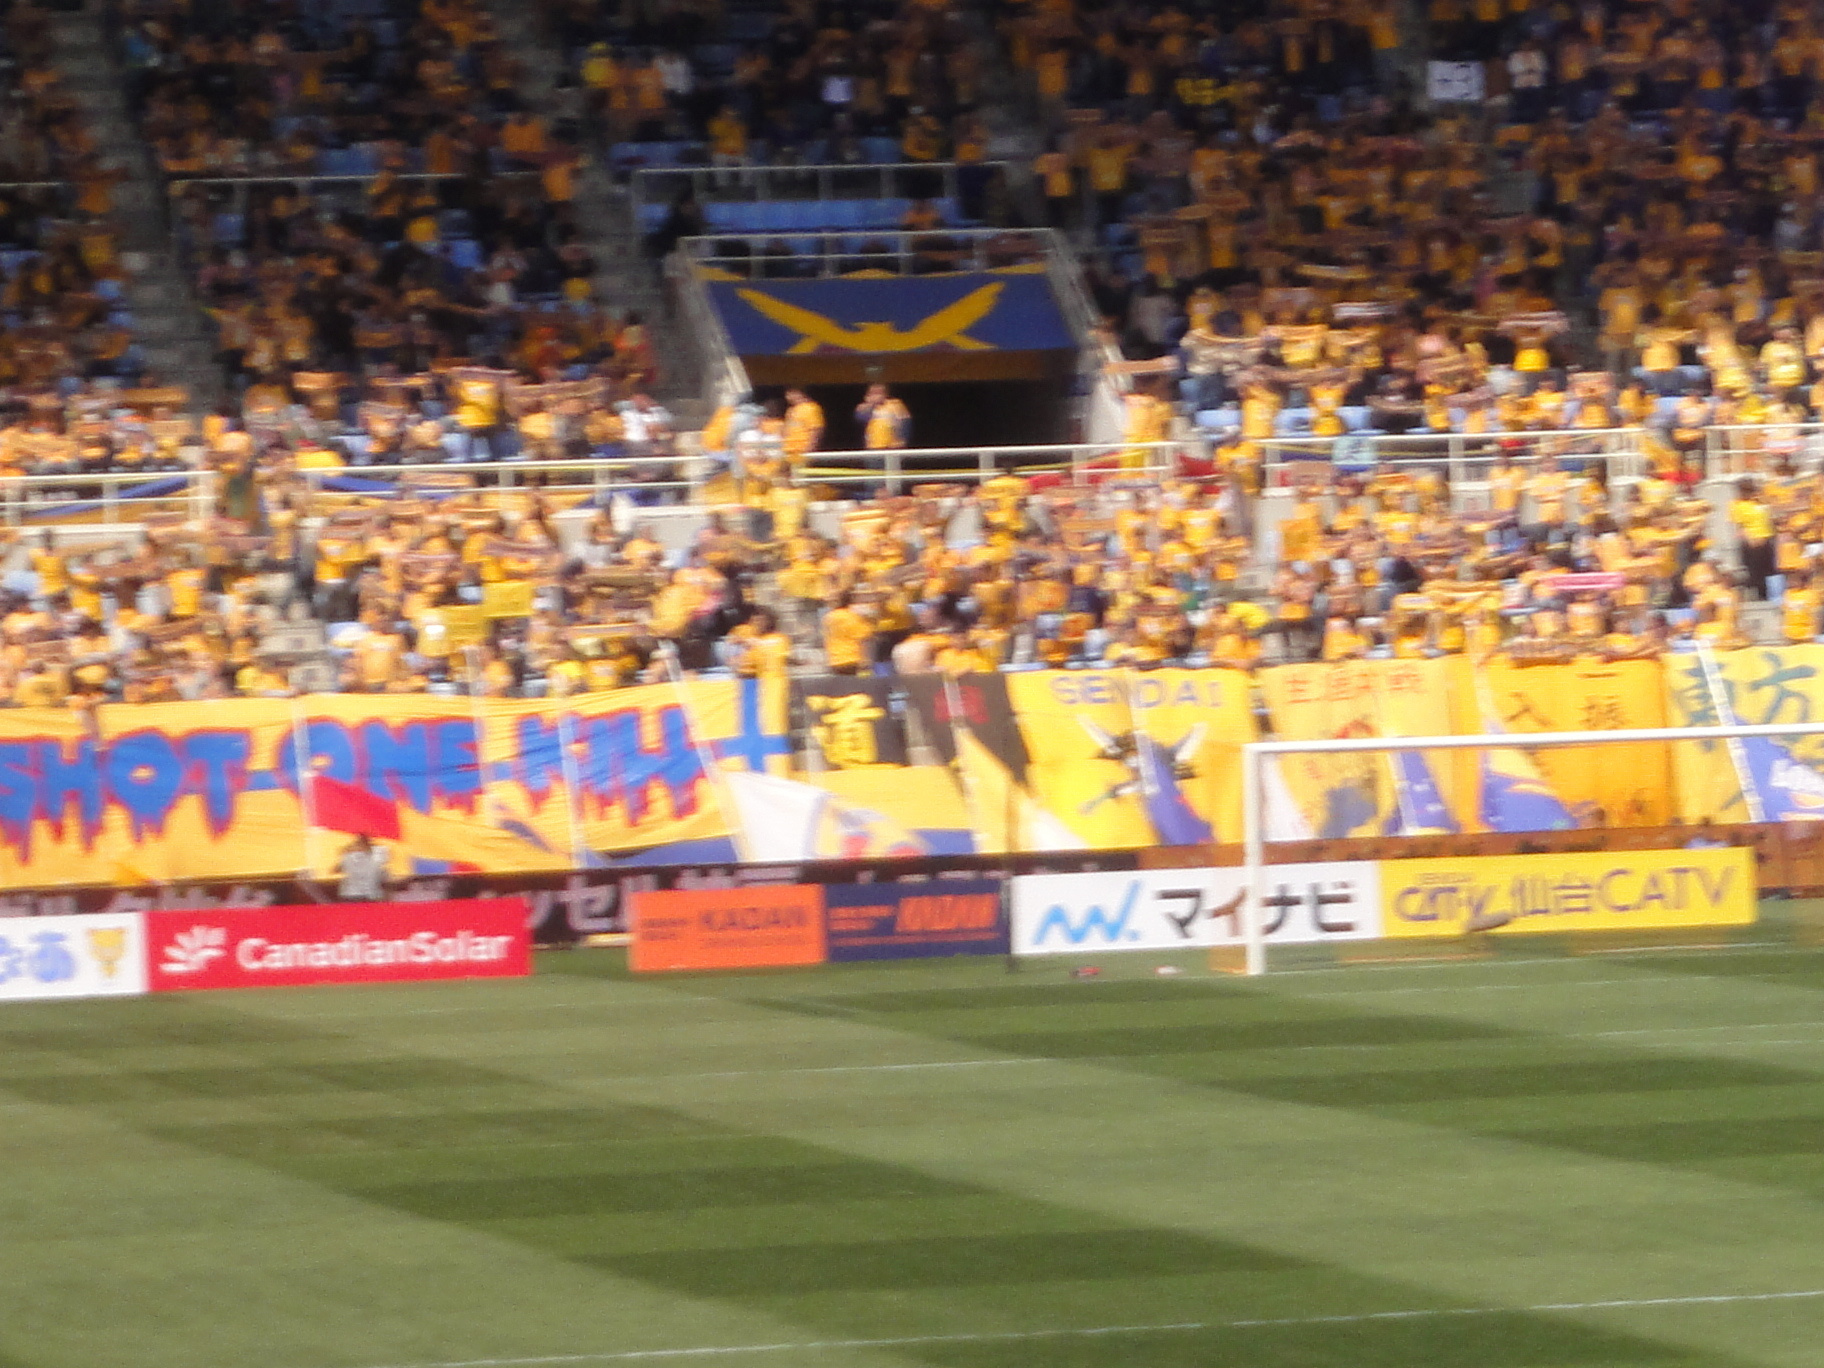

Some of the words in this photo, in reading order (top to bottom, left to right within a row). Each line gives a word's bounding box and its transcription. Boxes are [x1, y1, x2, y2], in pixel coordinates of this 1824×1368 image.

[0, 728, 250, 864] SHOT
[1156, 881, 1359, 940] マイナビ
